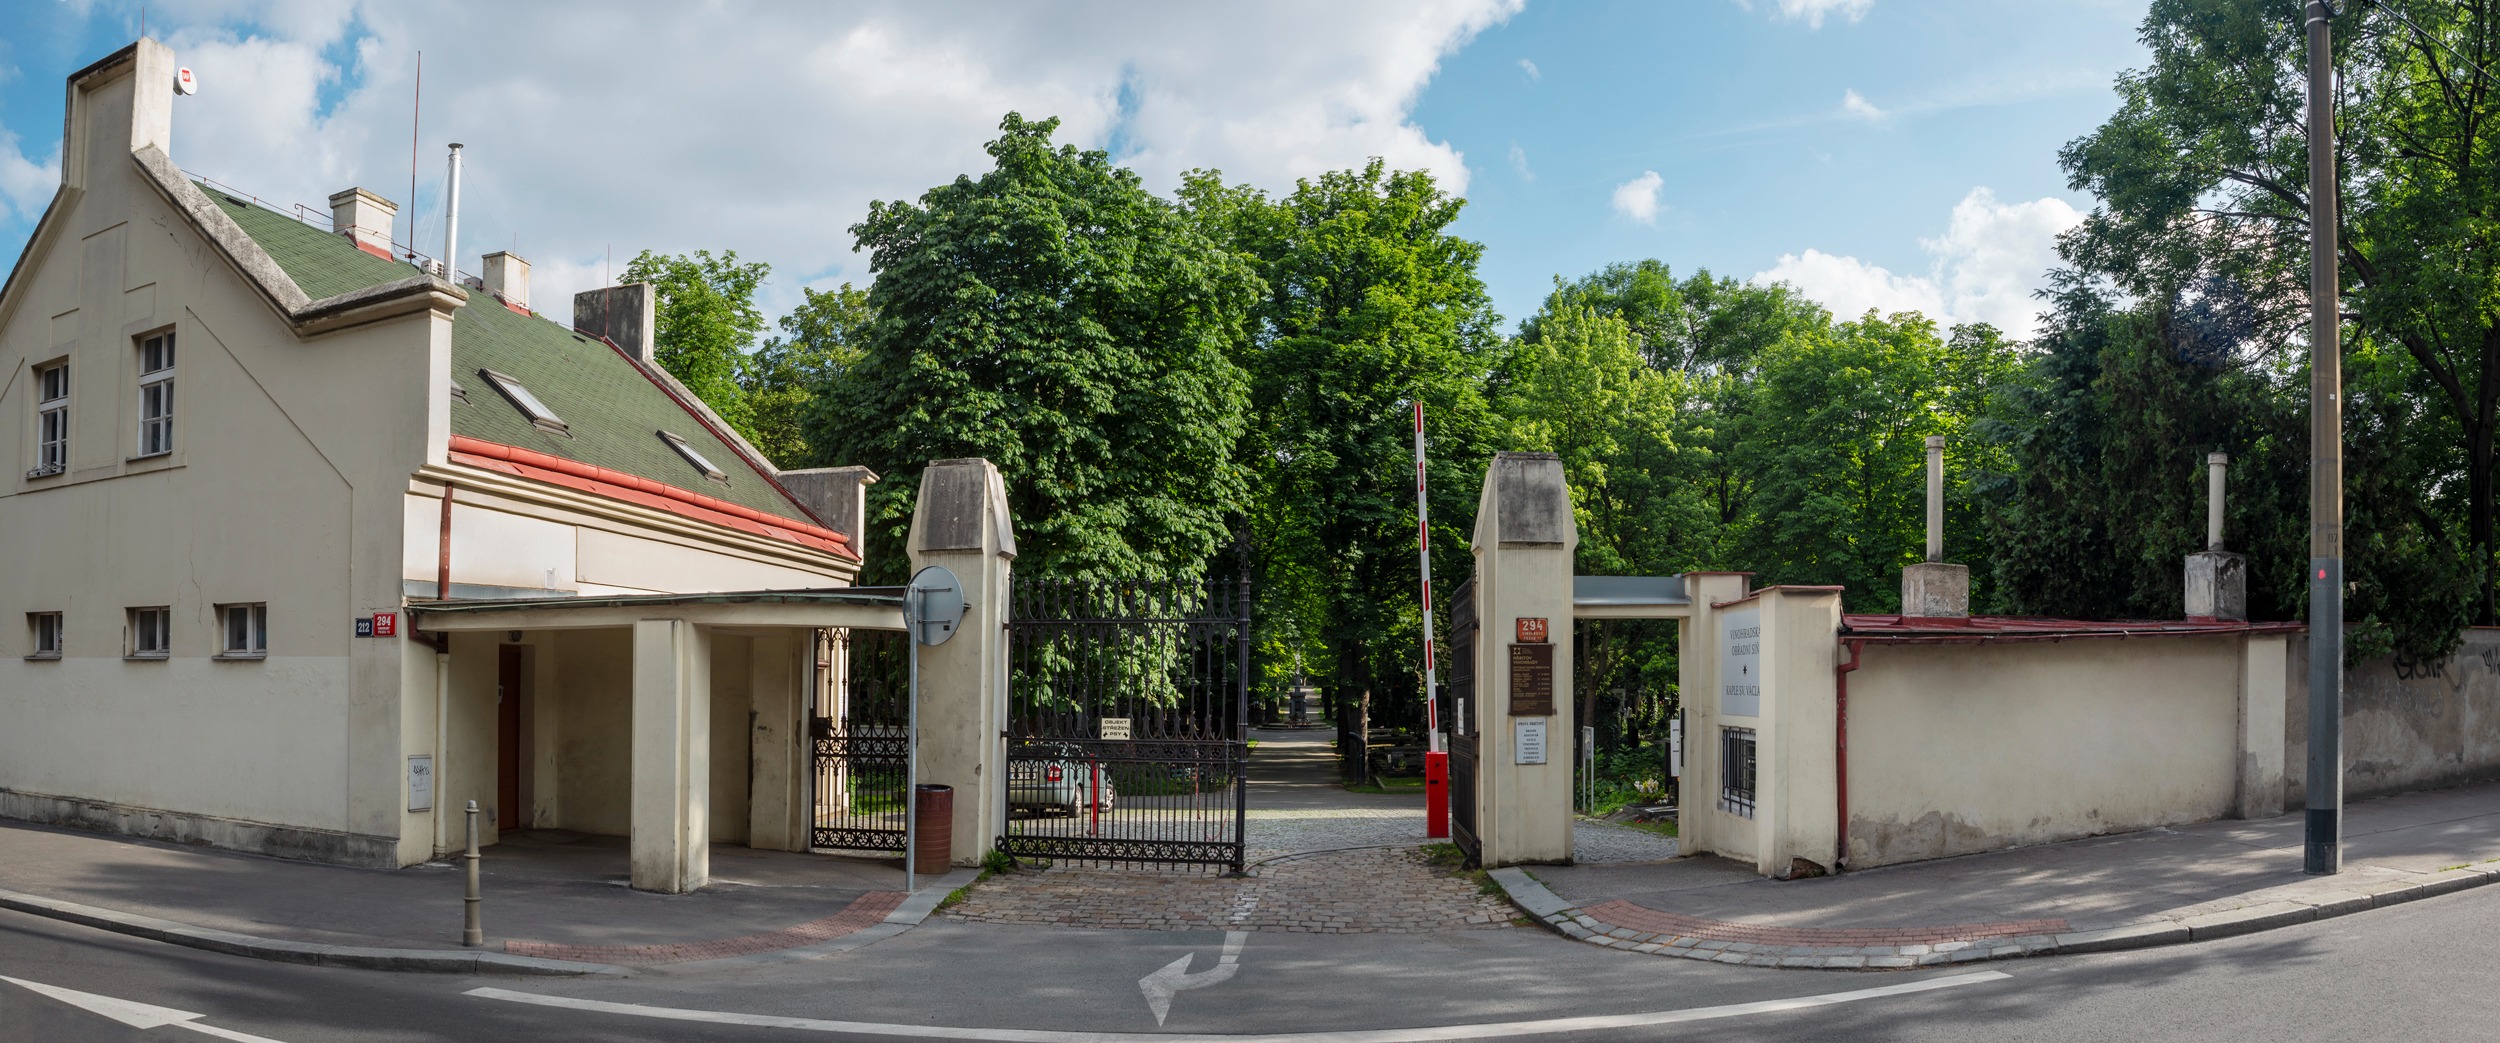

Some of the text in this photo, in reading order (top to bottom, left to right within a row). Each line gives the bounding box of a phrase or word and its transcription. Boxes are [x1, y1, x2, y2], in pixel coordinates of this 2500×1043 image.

[377, 616, 391, 626] 294
[1522, 620, 1542, 630] 294
[358, 622, 370, 632] 212
[1732, 644, 1750, 656] OBŘADNÍ
[1726, 686, 1738, 696] KAPLE
